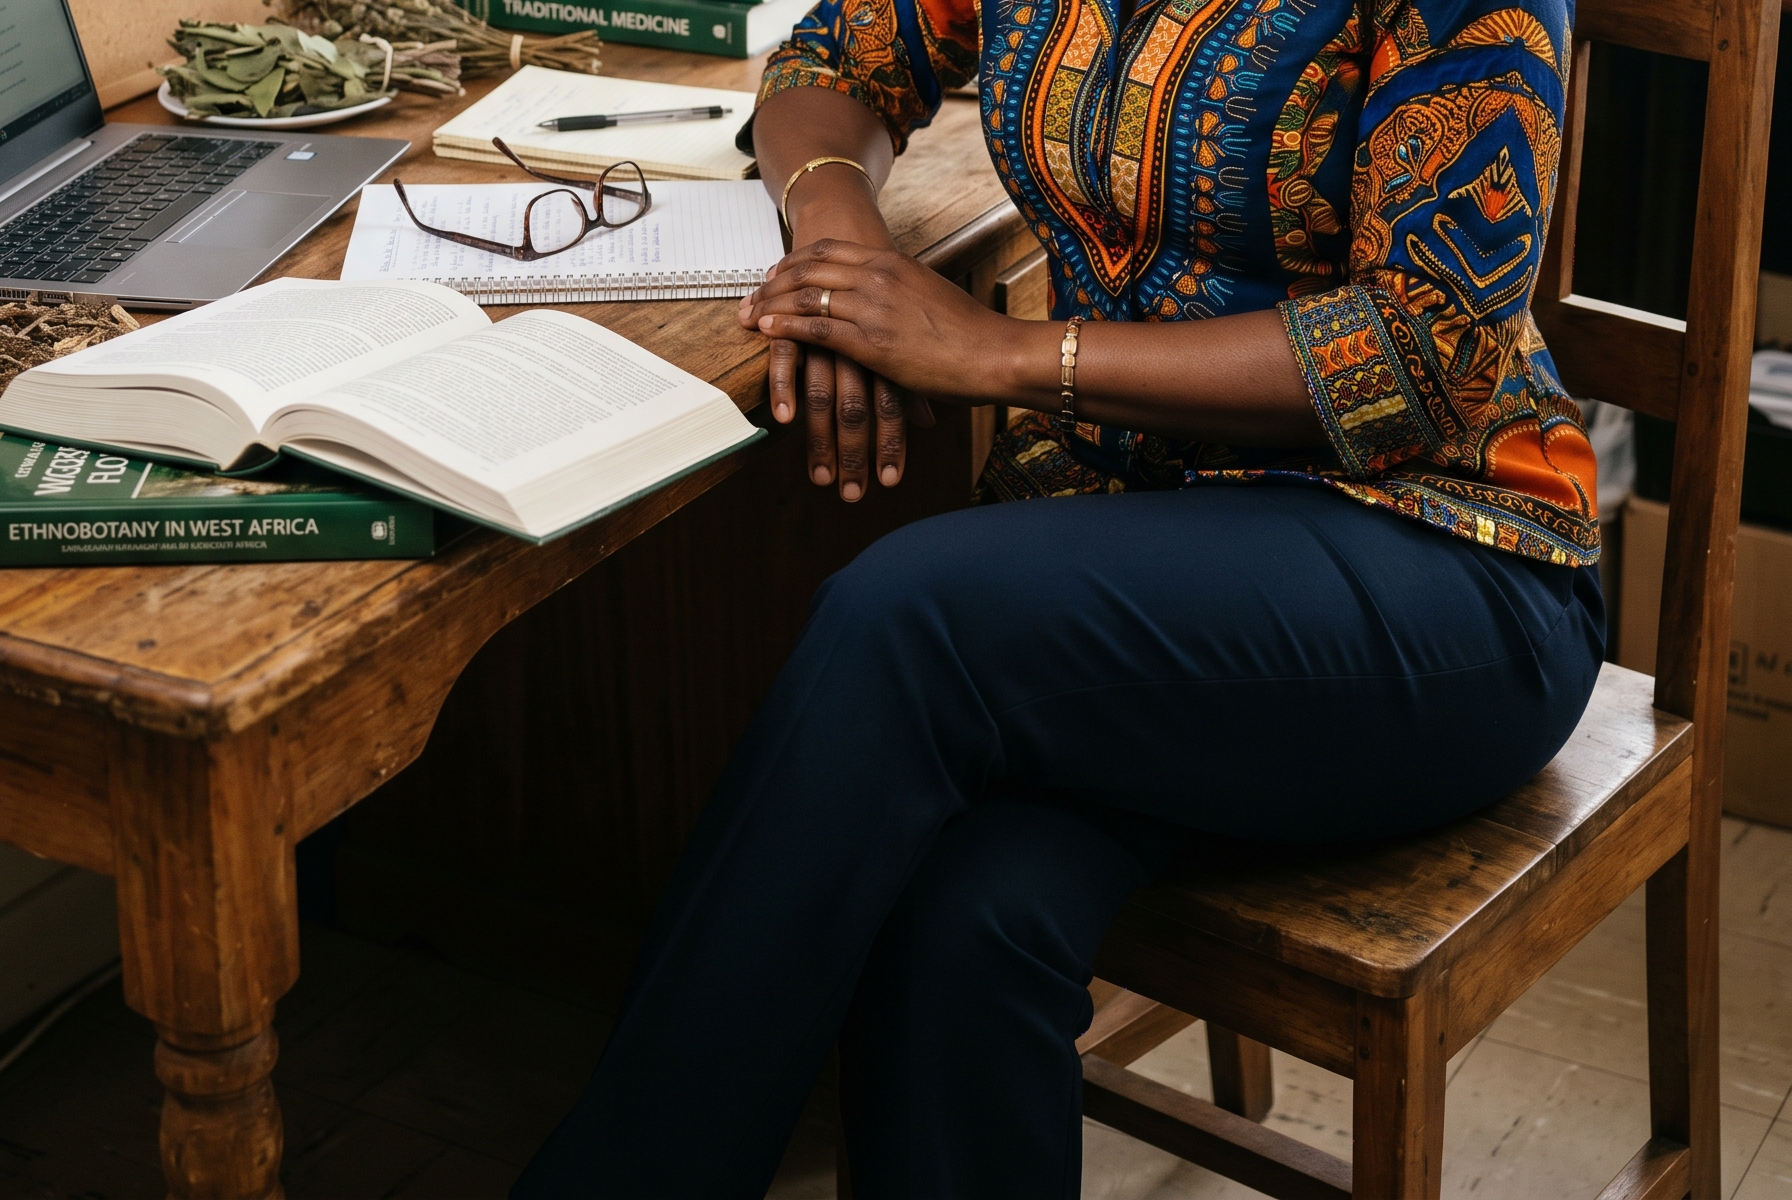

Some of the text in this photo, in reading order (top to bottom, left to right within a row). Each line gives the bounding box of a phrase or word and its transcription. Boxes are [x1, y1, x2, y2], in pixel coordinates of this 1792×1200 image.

[611, 10, 691, 37] MEDICINE
[86, 453, 129, 484] FLO
[8, 517, 319, 541] ETHNOBOTANY IN WEST AFRICA
